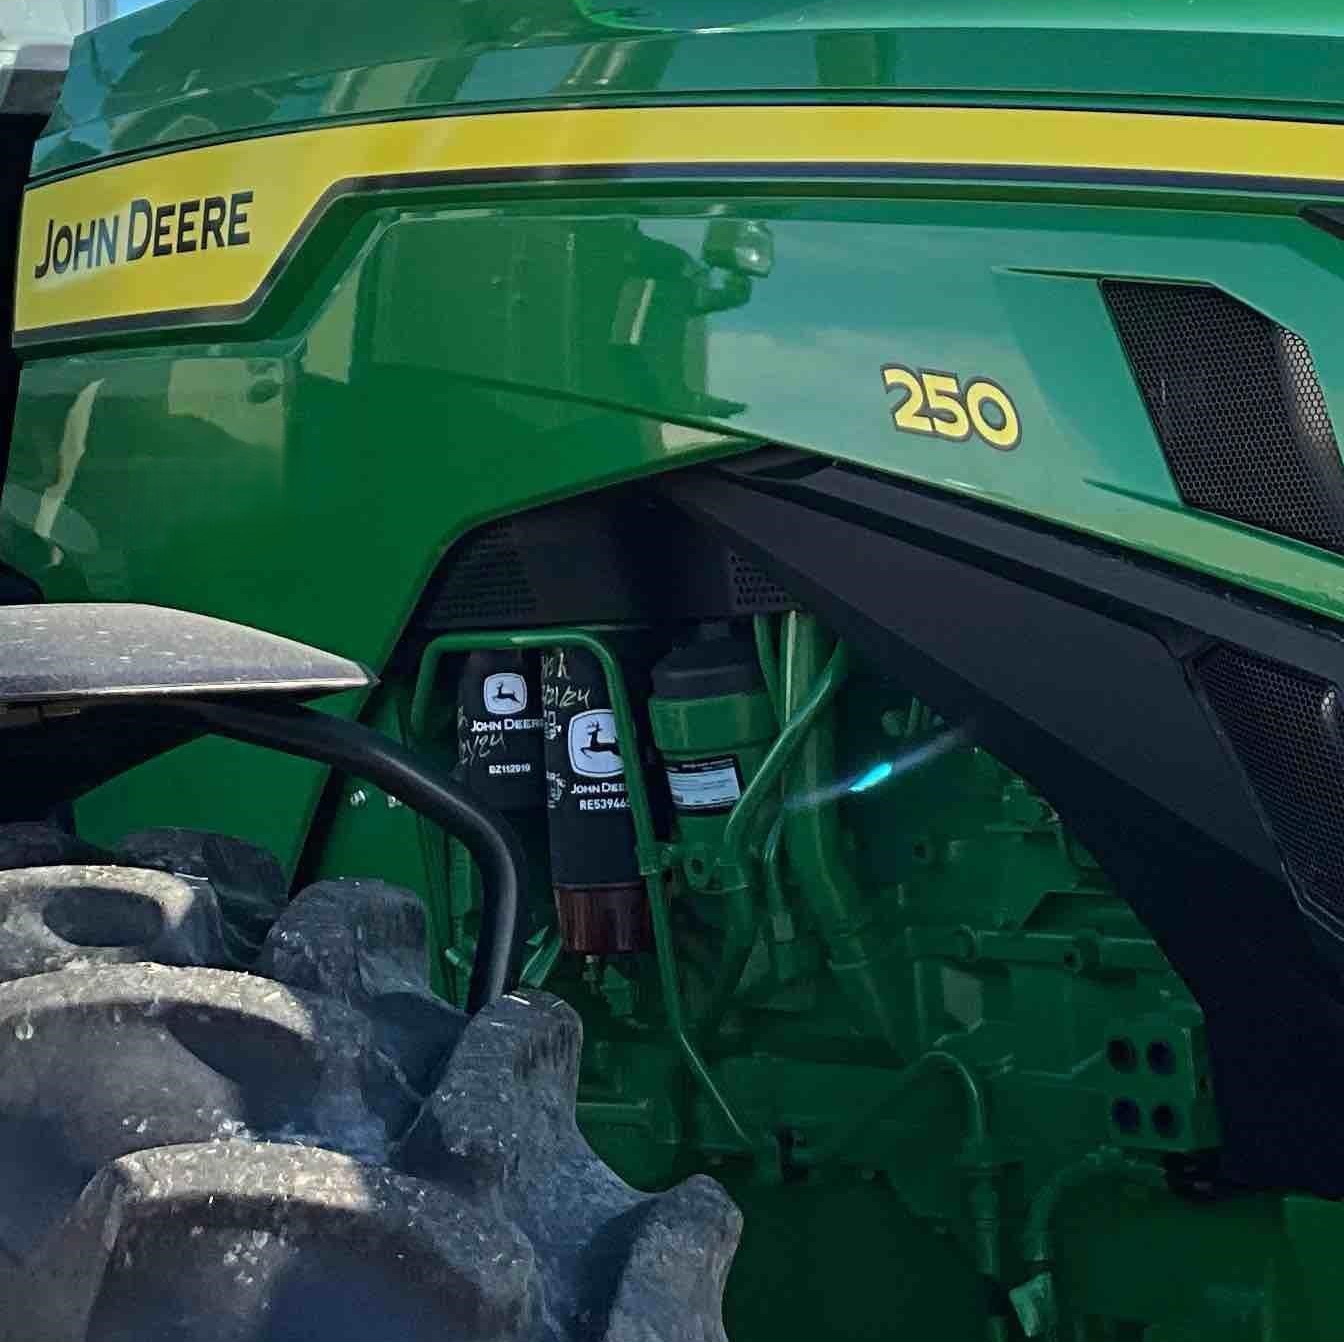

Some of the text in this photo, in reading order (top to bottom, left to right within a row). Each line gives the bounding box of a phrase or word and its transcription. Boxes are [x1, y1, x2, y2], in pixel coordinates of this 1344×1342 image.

[34, 190, 254, 279] JOHN DEERE
[881, 364, 1022, 450] 250
[470, 719, 502, 732] JOHN
[570, 781, 625, 795] JOHN DEE
